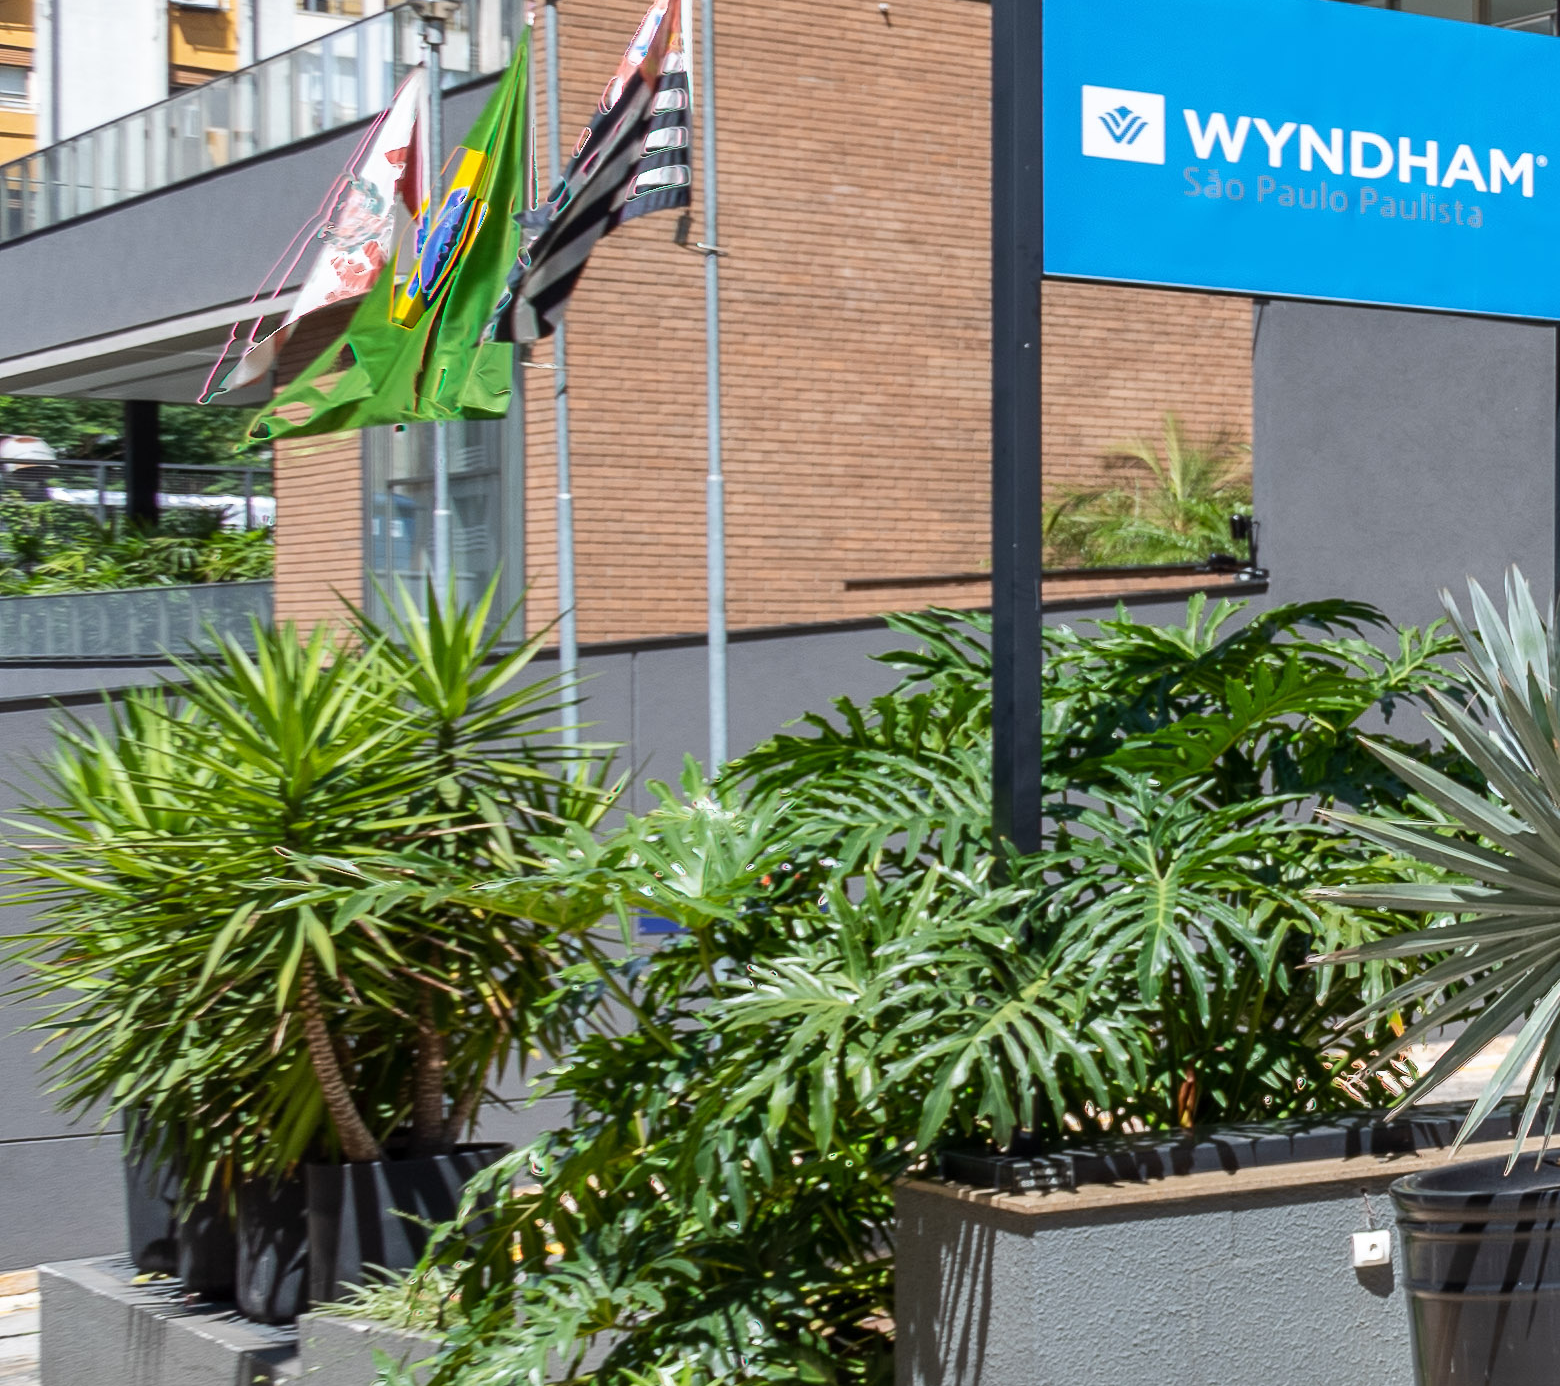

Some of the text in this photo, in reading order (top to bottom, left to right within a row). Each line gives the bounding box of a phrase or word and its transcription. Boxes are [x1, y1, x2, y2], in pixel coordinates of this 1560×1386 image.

[1184, 167, 1484, 229] São Paulo Paulista
